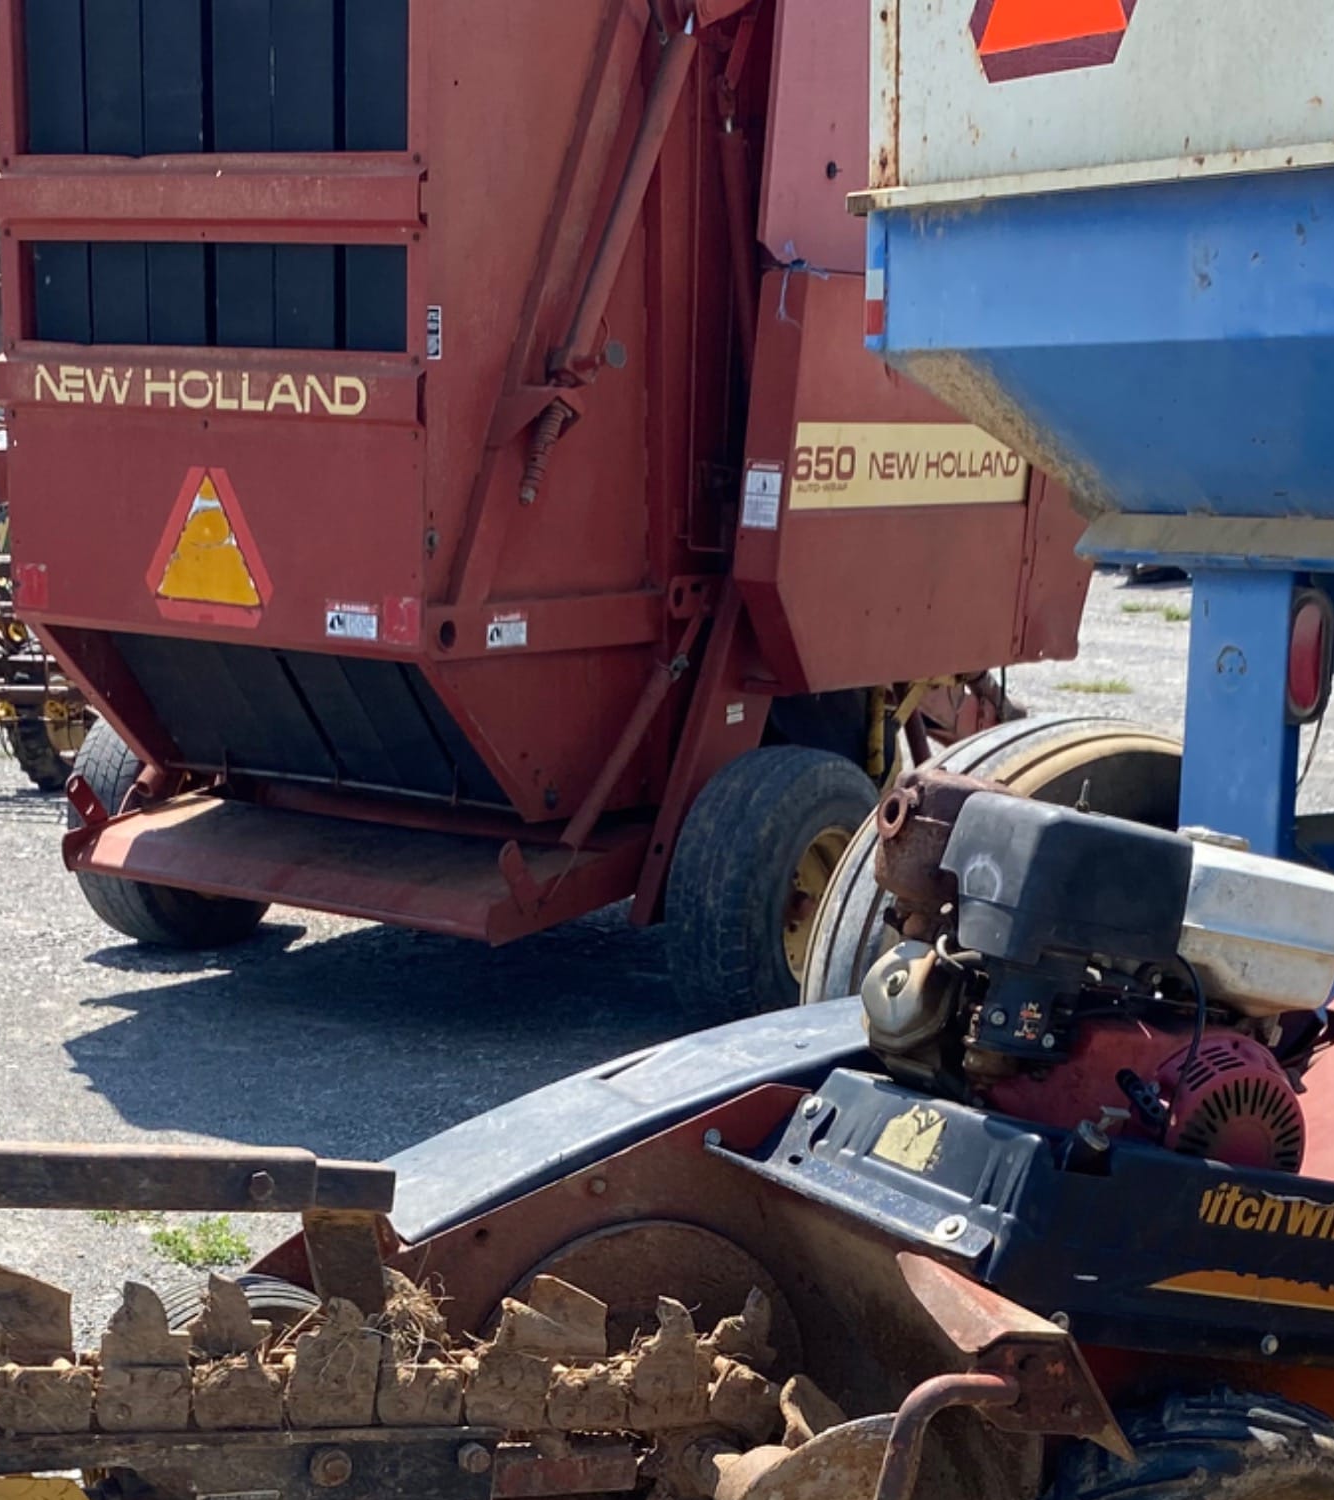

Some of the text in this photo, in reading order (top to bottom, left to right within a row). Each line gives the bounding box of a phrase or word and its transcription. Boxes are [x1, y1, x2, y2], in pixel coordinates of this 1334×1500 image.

[34, 364, 367, 416] NEW HOLLAND
[794, 447, 1020, 481] 650 NEW HOLLAND
